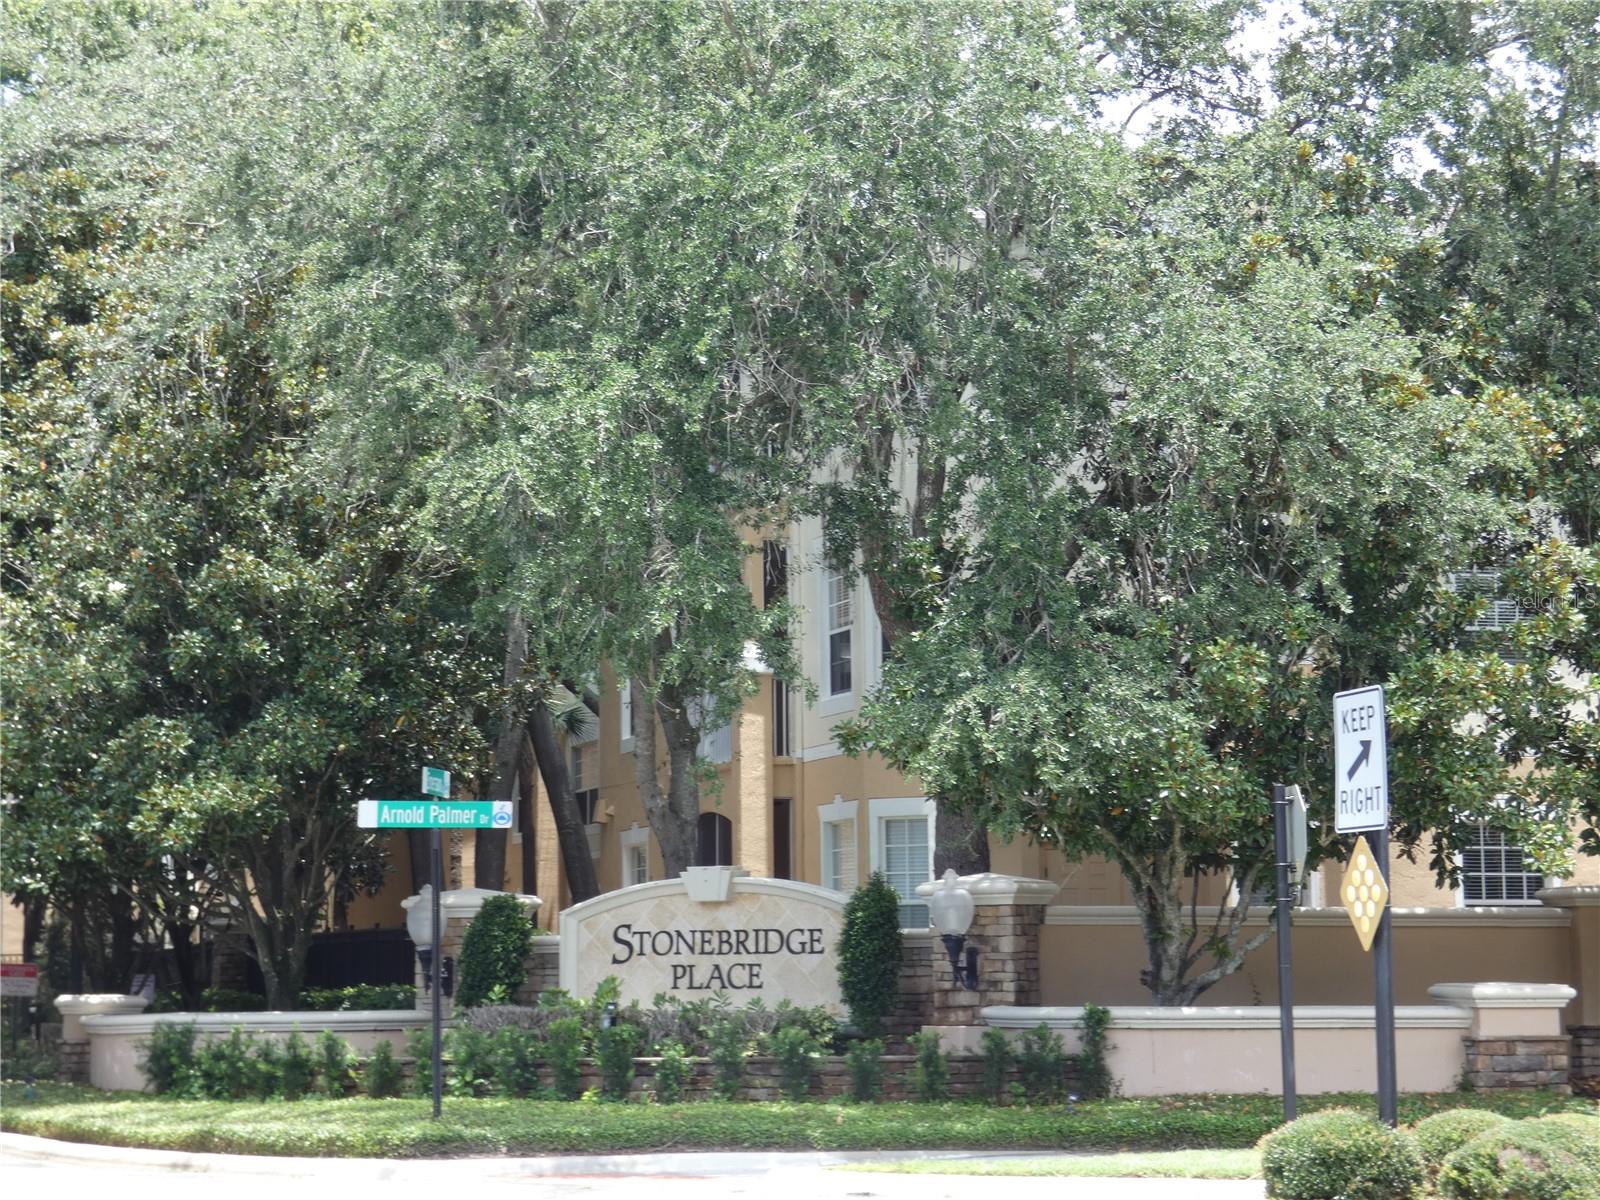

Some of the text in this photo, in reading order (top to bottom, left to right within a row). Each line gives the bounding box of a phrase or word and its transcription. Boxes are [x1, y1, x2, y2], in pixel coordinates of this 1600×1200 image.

[1341, 704, 1375, 734] KEEP
[380, 805, 490, 824] Arnold Palmer Dr
[1340, 786, 1381, 815] RIGHT
[611, 924, 825, 965] STONEBRIDGE
[671, 964, 764, 989] PLACE
